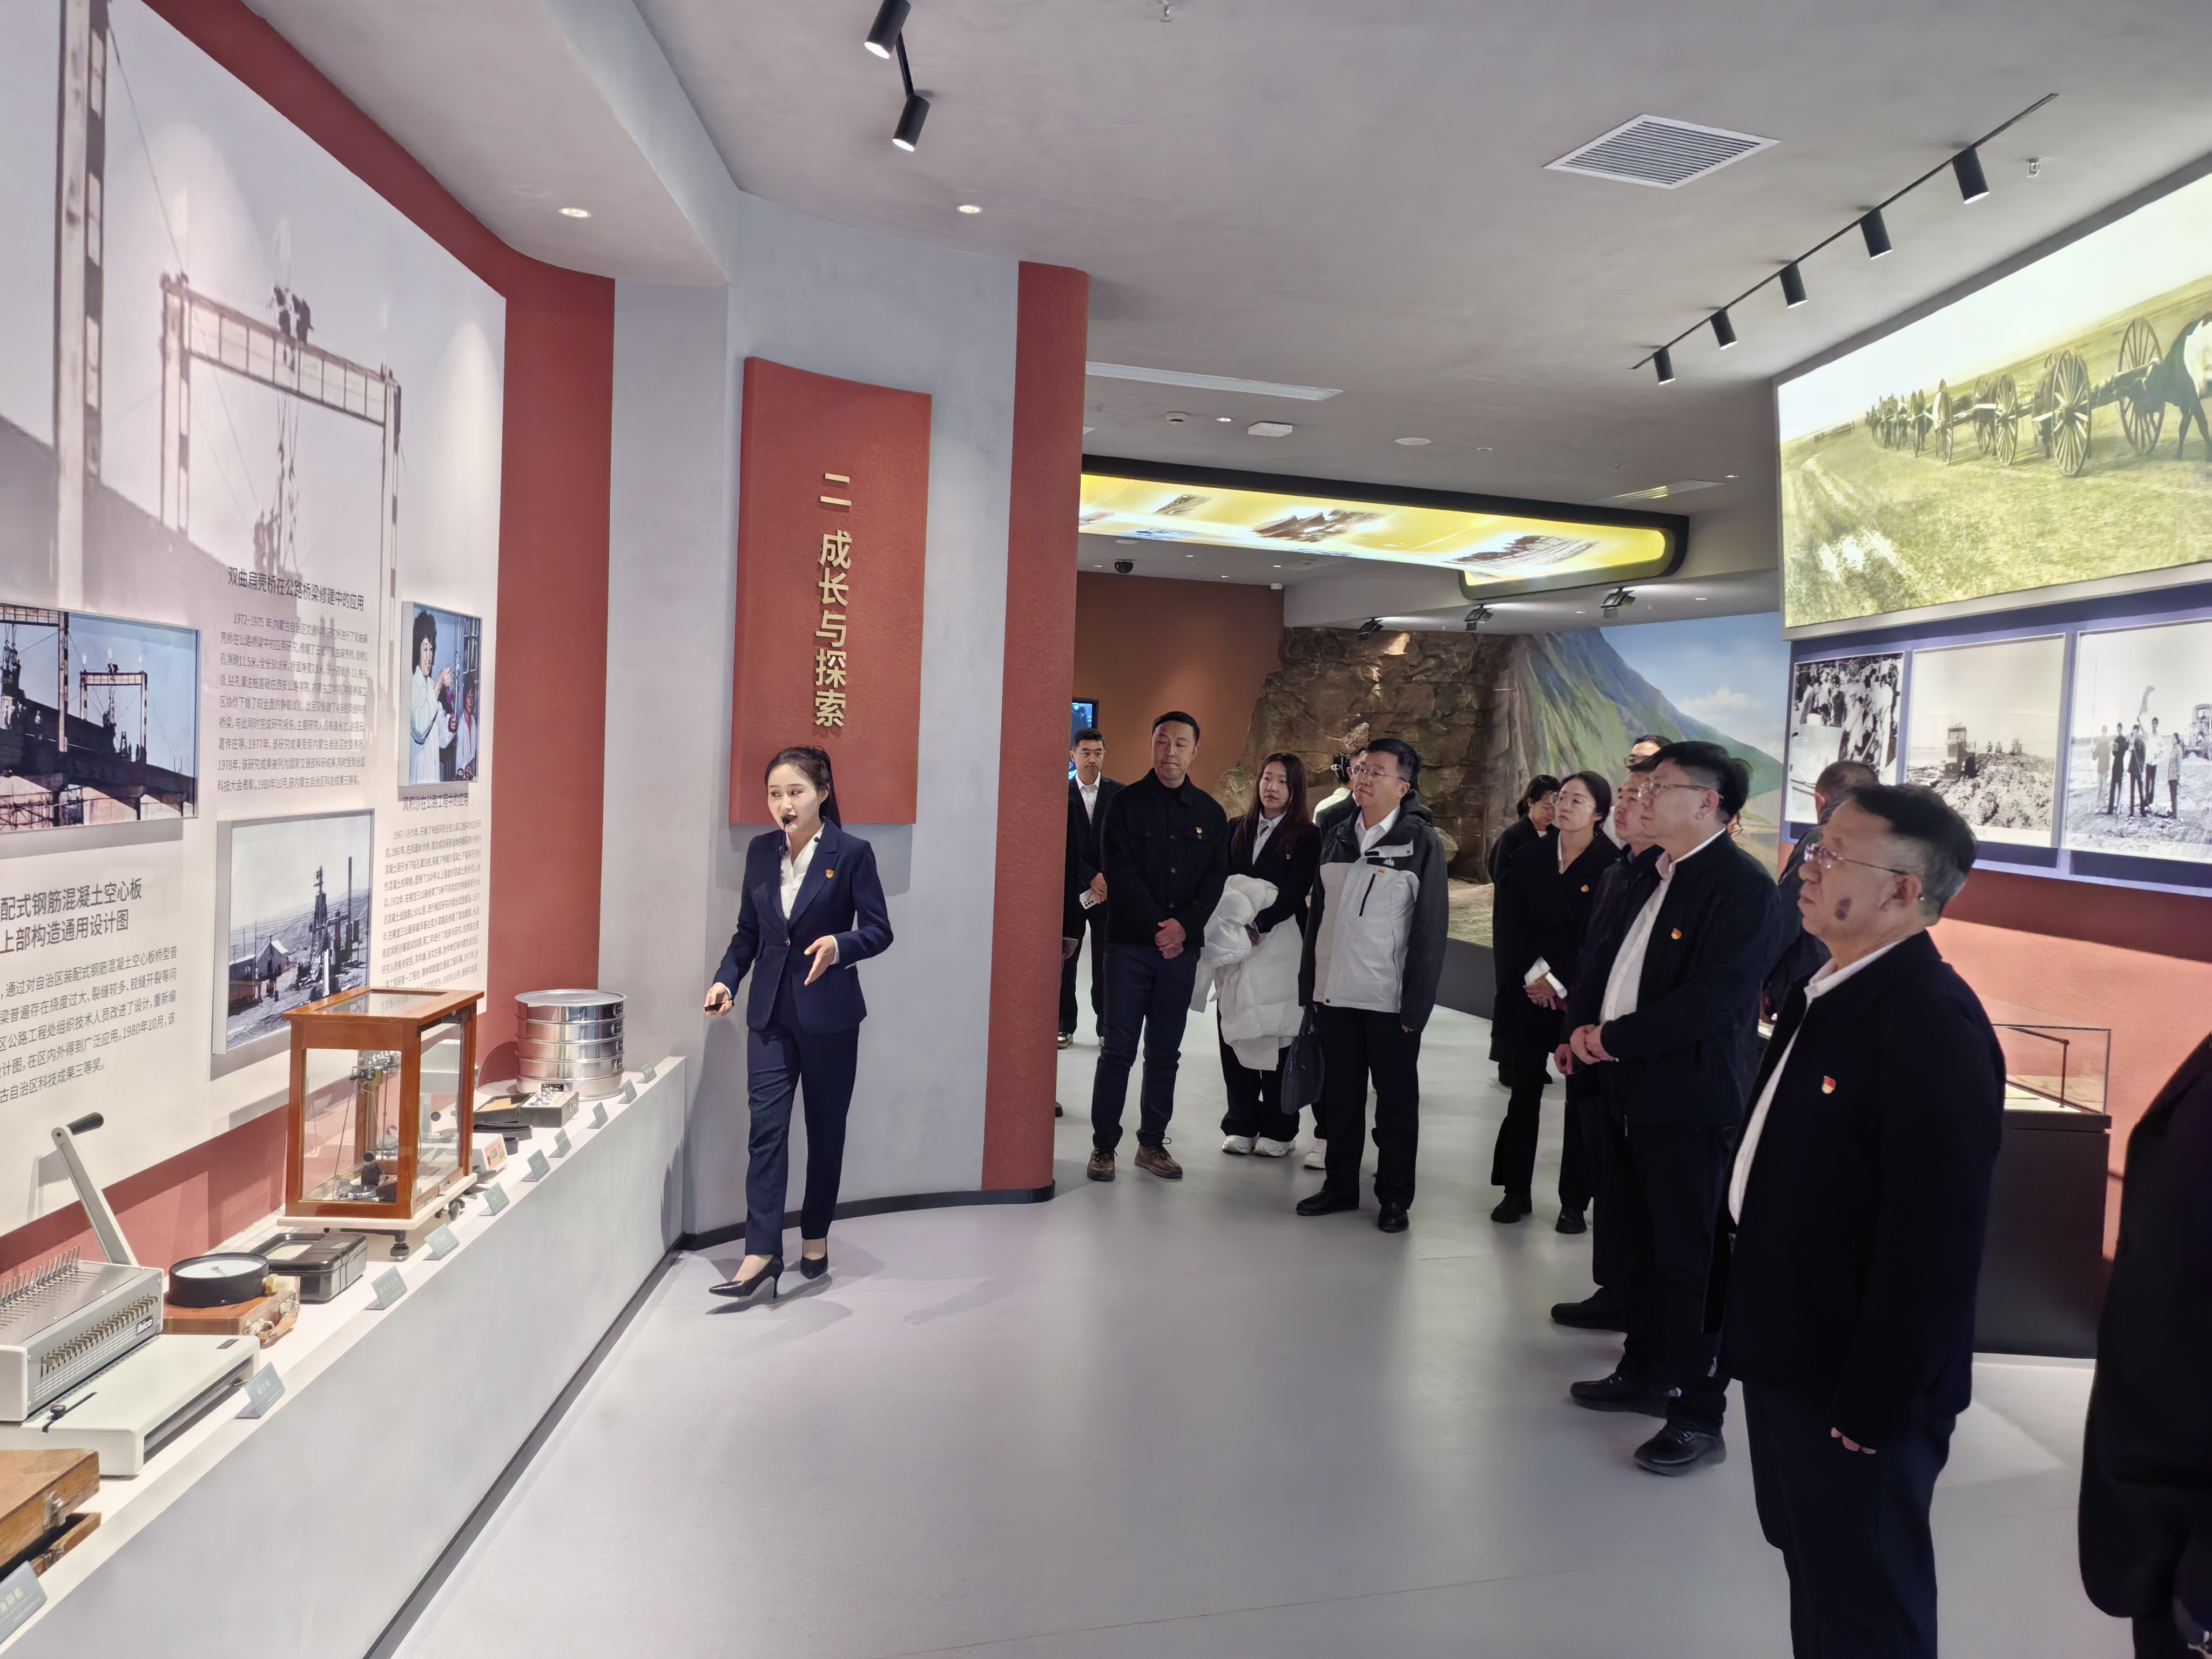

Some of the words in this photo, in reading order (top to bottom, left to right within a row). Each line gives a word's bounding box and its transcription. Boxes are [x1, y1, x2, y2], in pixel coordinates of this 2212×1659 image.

[820, 472, 852, 507] 二
[228, 566, 364, 611] 双曲扁壳桥在公路桥梁修建中的应用
[815, 529, 852, 727] 成长与探索
[402, 792, 469, 812] 风积沙在公路工程中的应用
[0, 878, 142, 922] 配式钢筋混凝土空心板
[0, 909, 129, 954] 上部构造通用设计图
[0, 1011, 176, 1078] 计图，在区内外得到广泛应用。1980年10月，该
